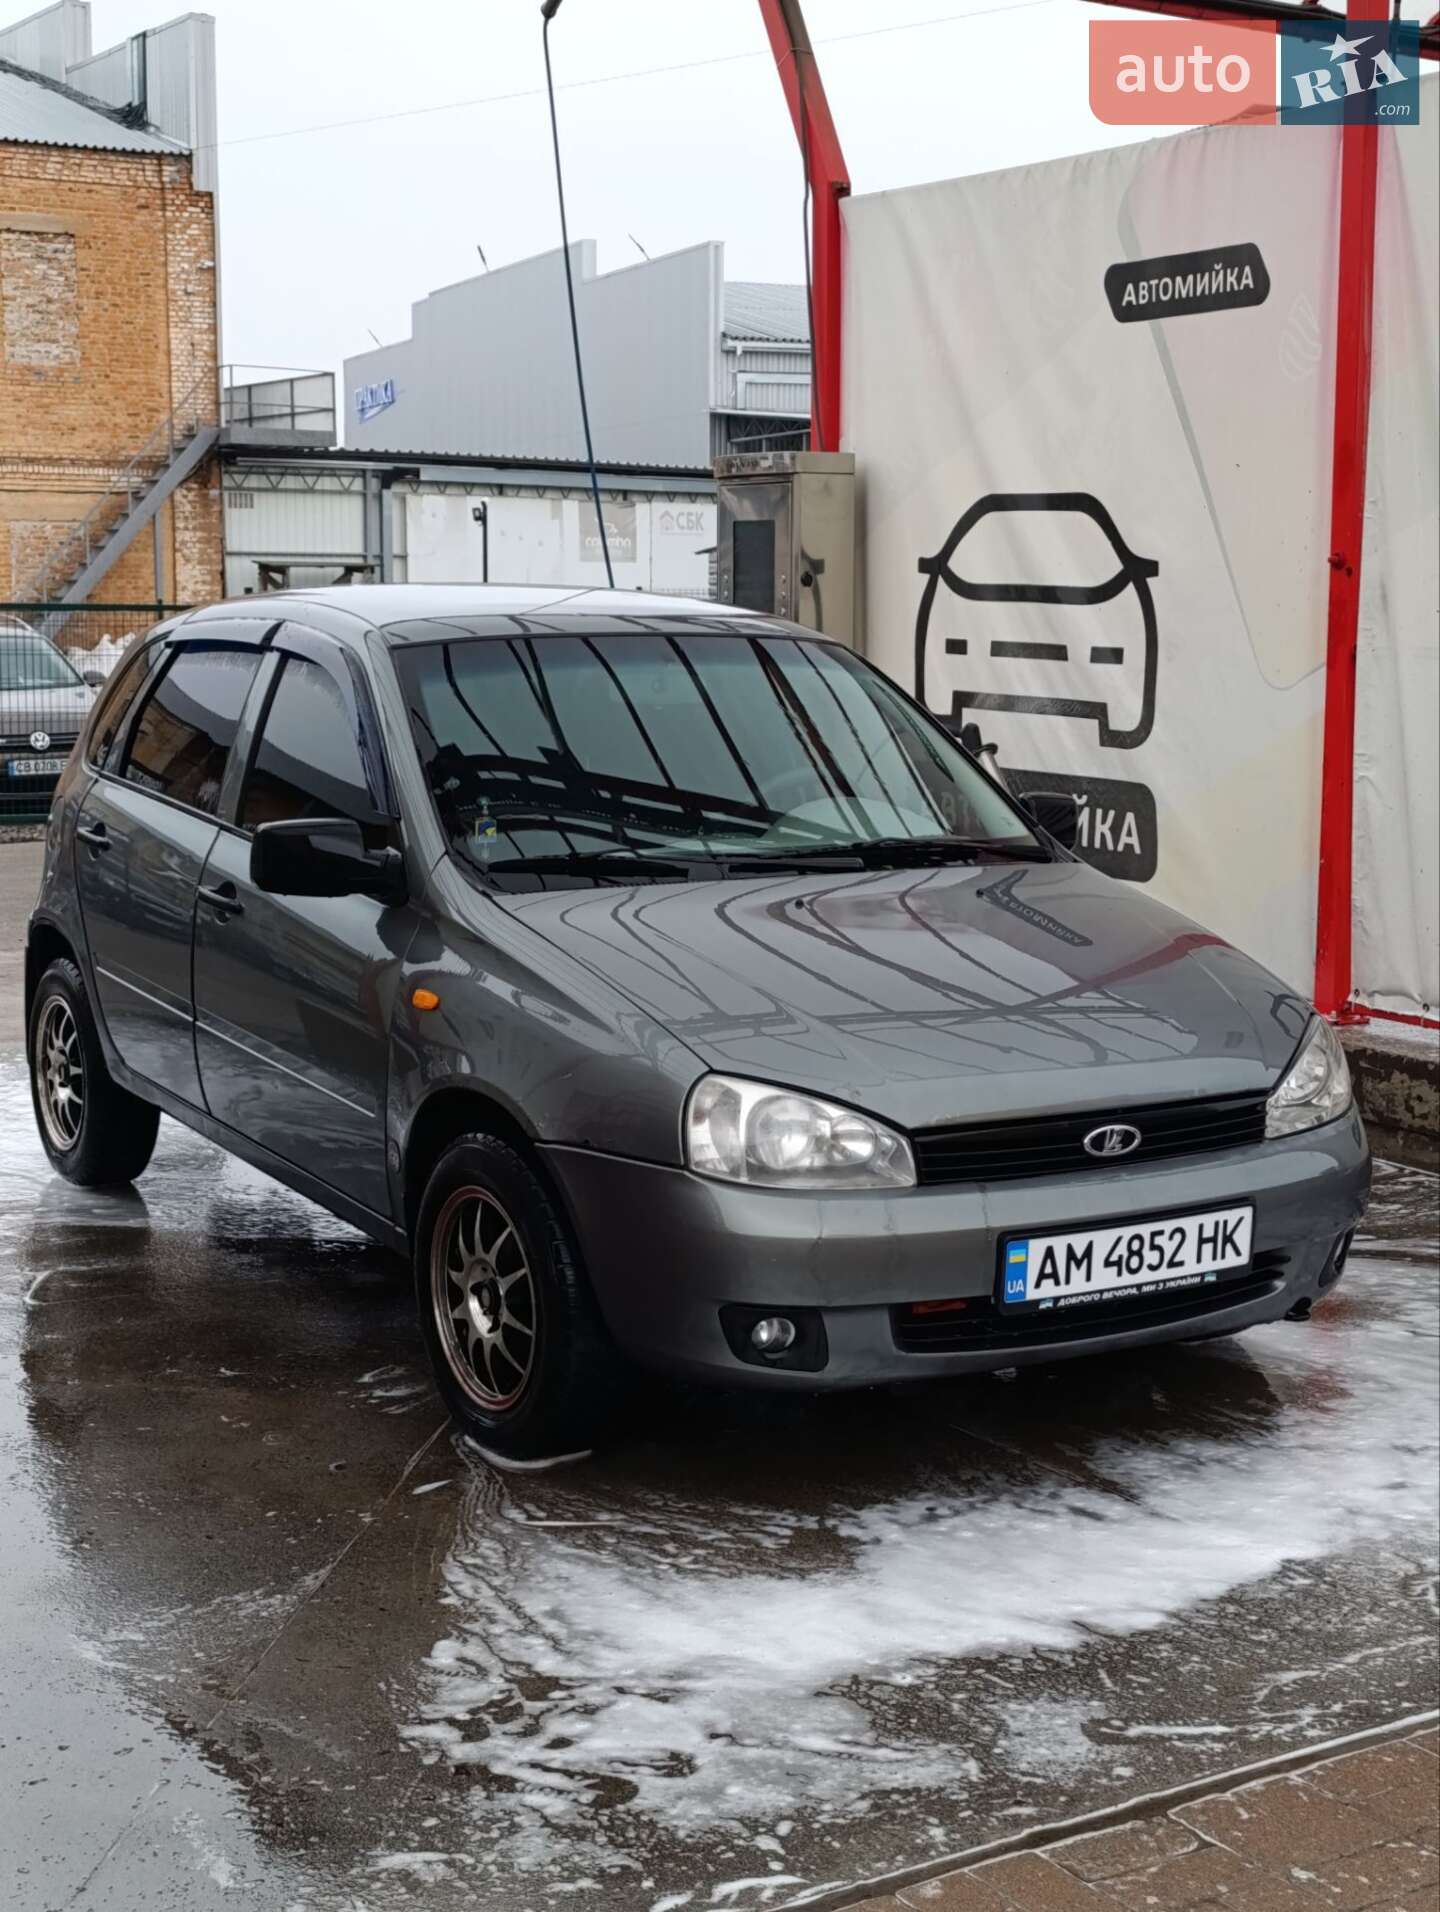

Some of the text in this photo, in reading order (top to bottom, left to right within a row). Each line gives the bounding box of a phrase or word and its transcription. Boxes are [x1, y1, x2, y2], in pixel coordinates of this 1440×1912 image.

[1121, 262, 1255, 307] АВТОМИЙКА
[675, 510, 705, 532] СБК
[1072, 793, 1142, 855] ЙКА
[1034, 1216, 1246, 1290] AM 4852 HK
[1007, 1279, 1024, 1294] UA
[1057, 1292, 1100, 1307] ДОБРОГО
[1102, 1286, 1139, 1301] ВЕЧОРА,
[1141, 1283, 1156, 1294] МИ
[1164, 1275, 1202, 1290] УКРАЇНИ
